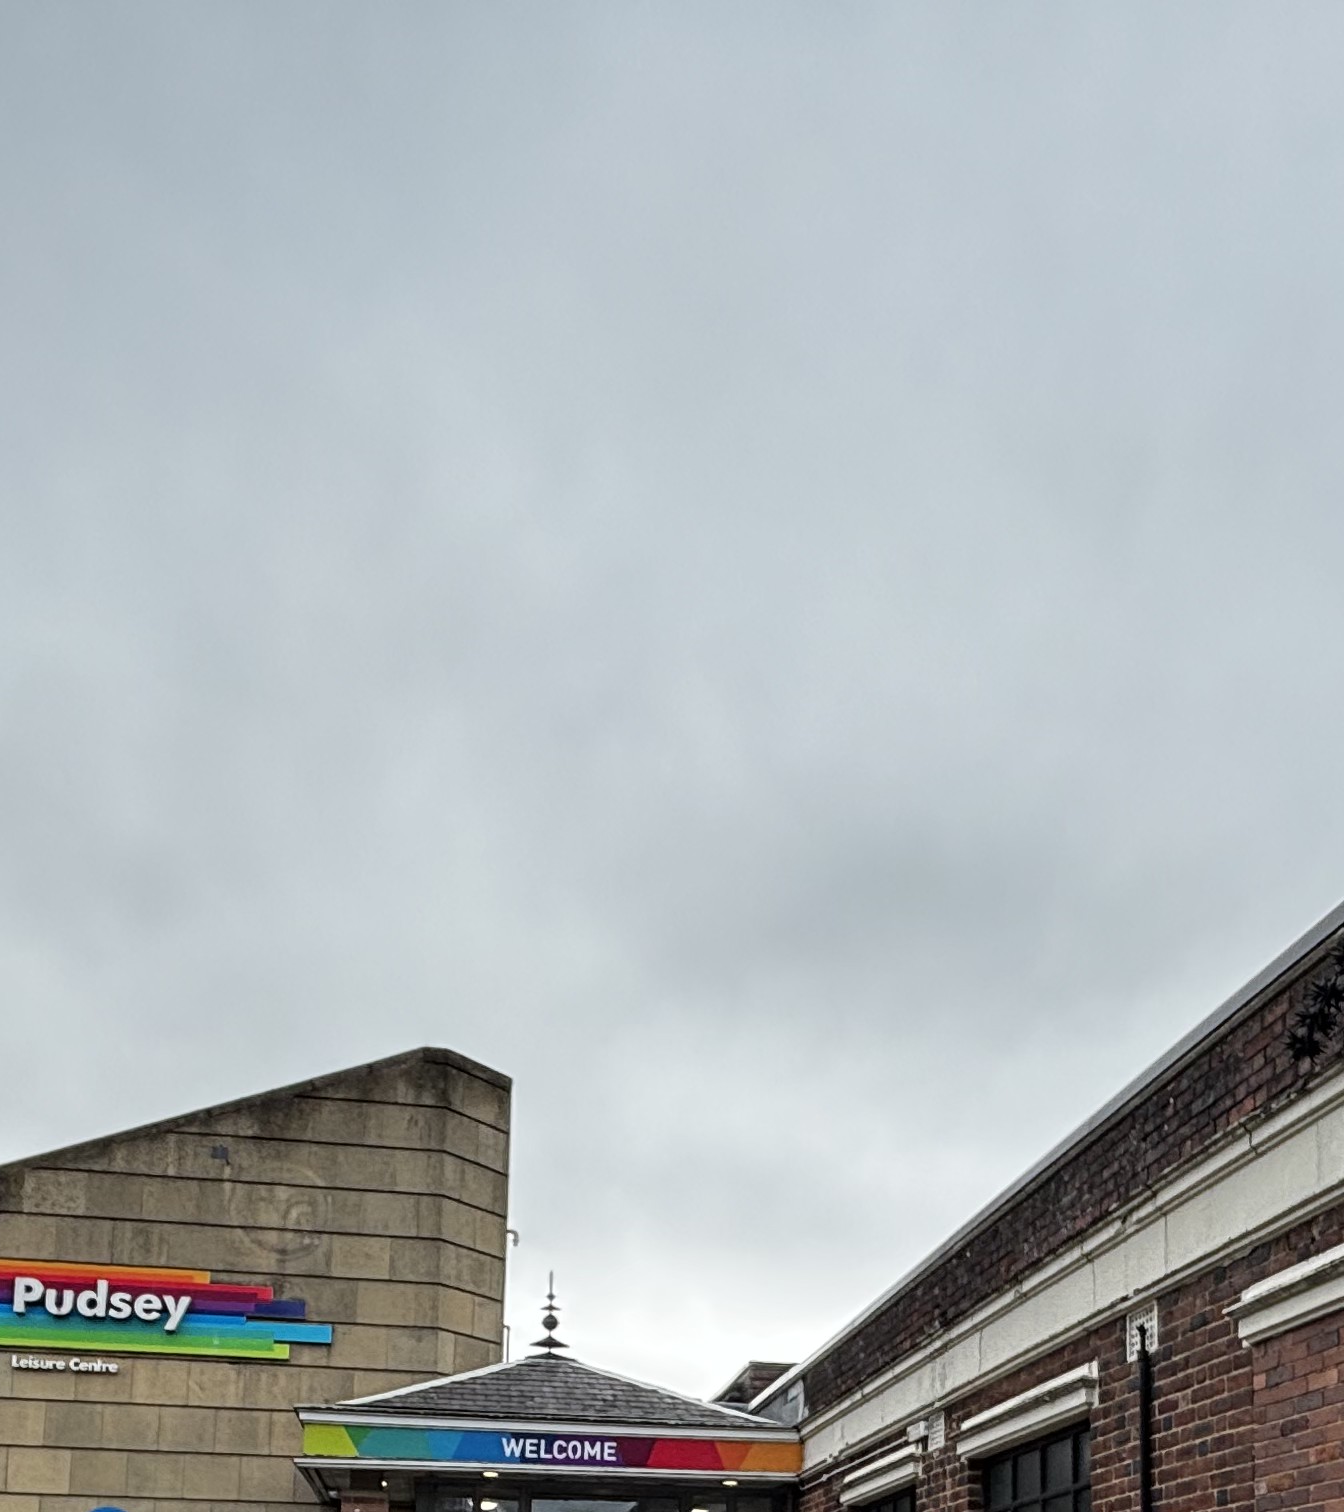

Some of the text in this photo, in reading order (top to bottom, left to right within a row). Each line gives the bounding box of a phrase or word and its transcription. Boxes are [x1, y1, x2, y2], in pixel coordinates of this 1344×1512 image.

[13, 1276, 192, 1331] Pudsey
[11, 1354, 119, 1374] Leisure Centre
[501, 1437, 617, 1461] WELCOME
